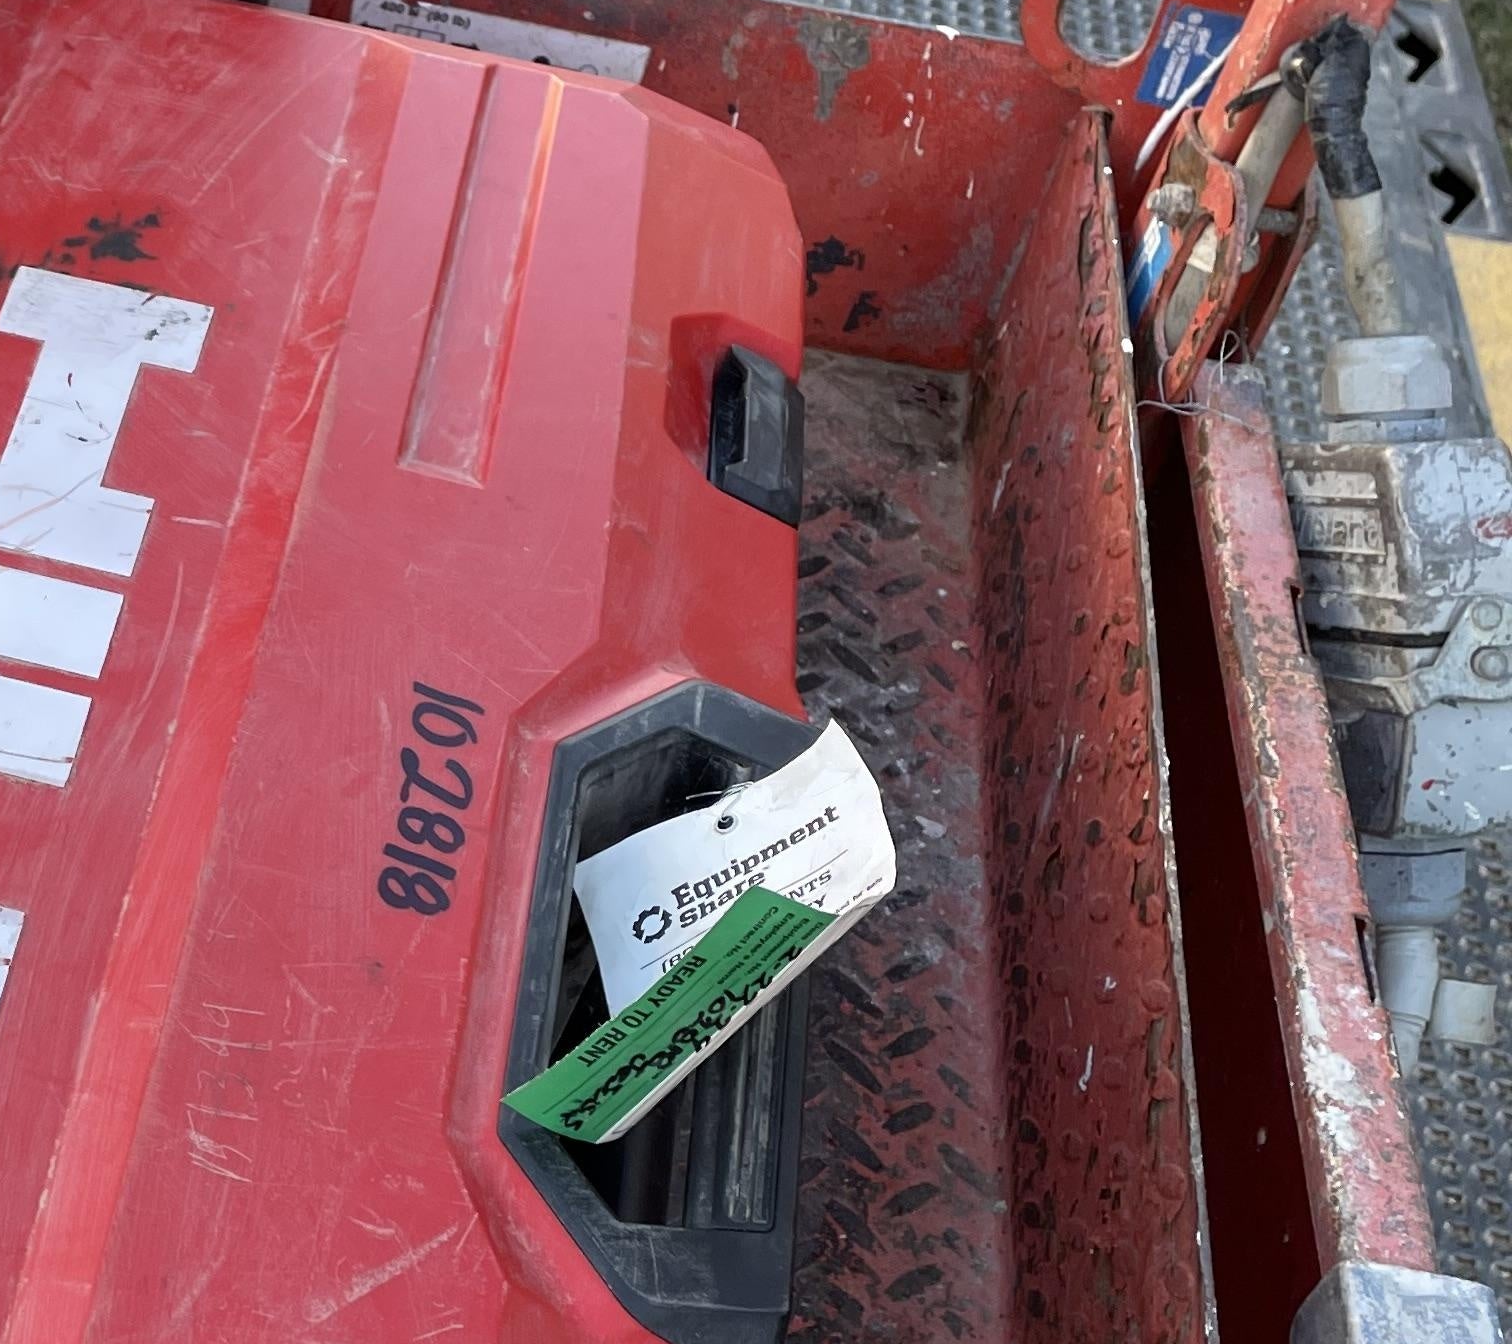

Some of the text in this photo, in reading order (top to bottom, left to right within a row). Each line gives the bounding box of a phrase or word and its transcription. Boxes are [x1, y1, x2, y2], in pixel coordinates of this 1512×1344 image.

[377, 681, 486, 916] 102818
[671, 806, 839, 910] Equipment
[679, 871, 766, 929] Share
[577, 955, 707, 1068] READY TO RENT
